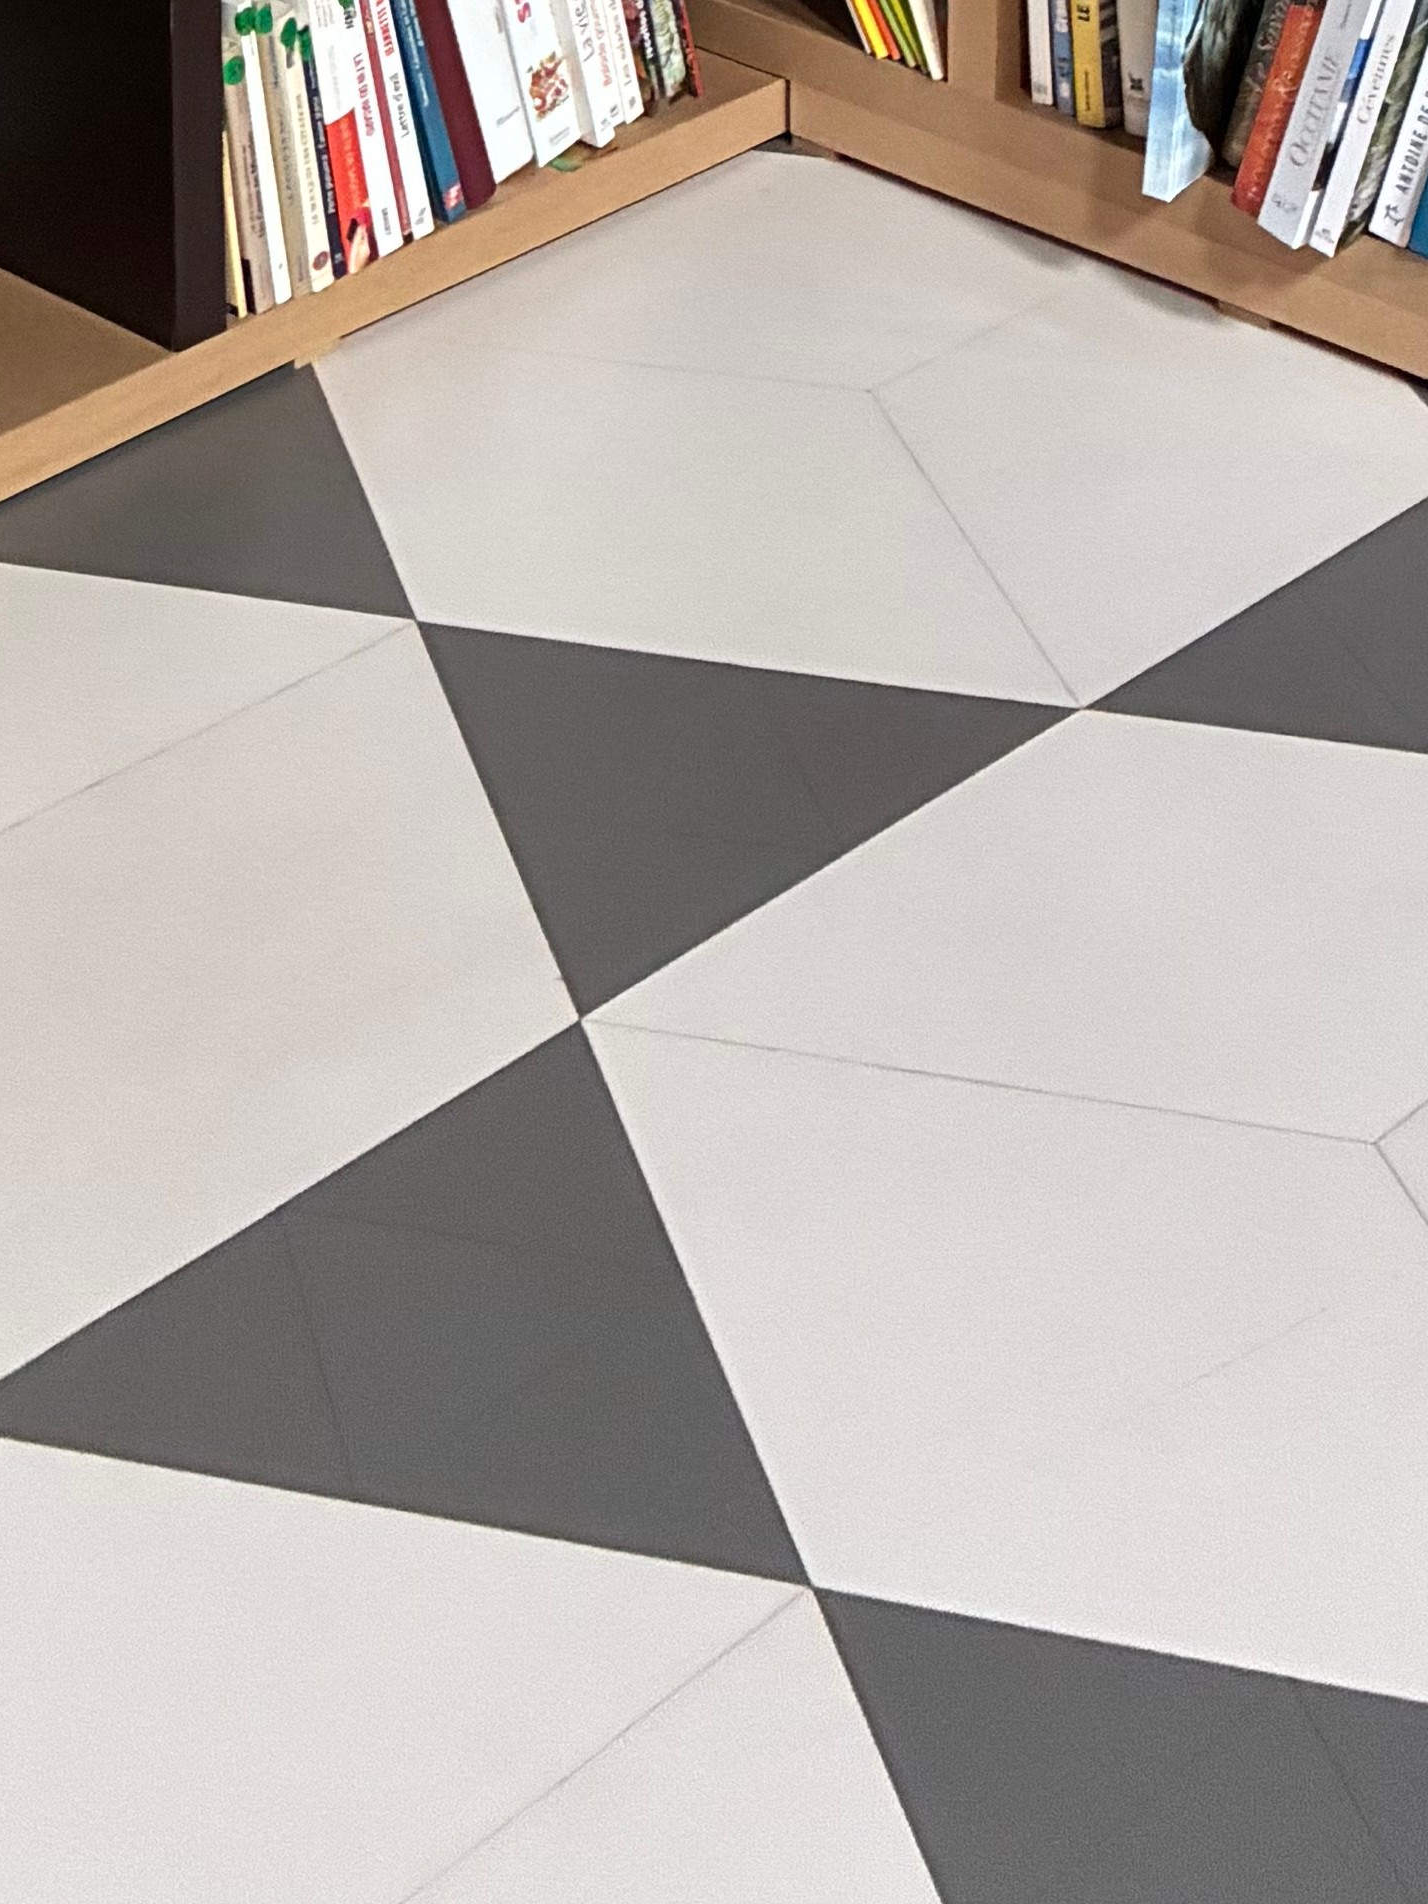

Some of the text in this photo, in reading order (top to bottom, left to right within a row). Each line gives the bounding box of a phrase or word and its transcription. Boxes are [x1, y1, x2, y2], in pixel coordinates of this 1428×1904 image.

[574, 2, 591, 35] vie
[1077, 2, 1091, 22] LE
[582, 36, 595, 63] La
[1395, 132, 1428, 195] ANTOINE
